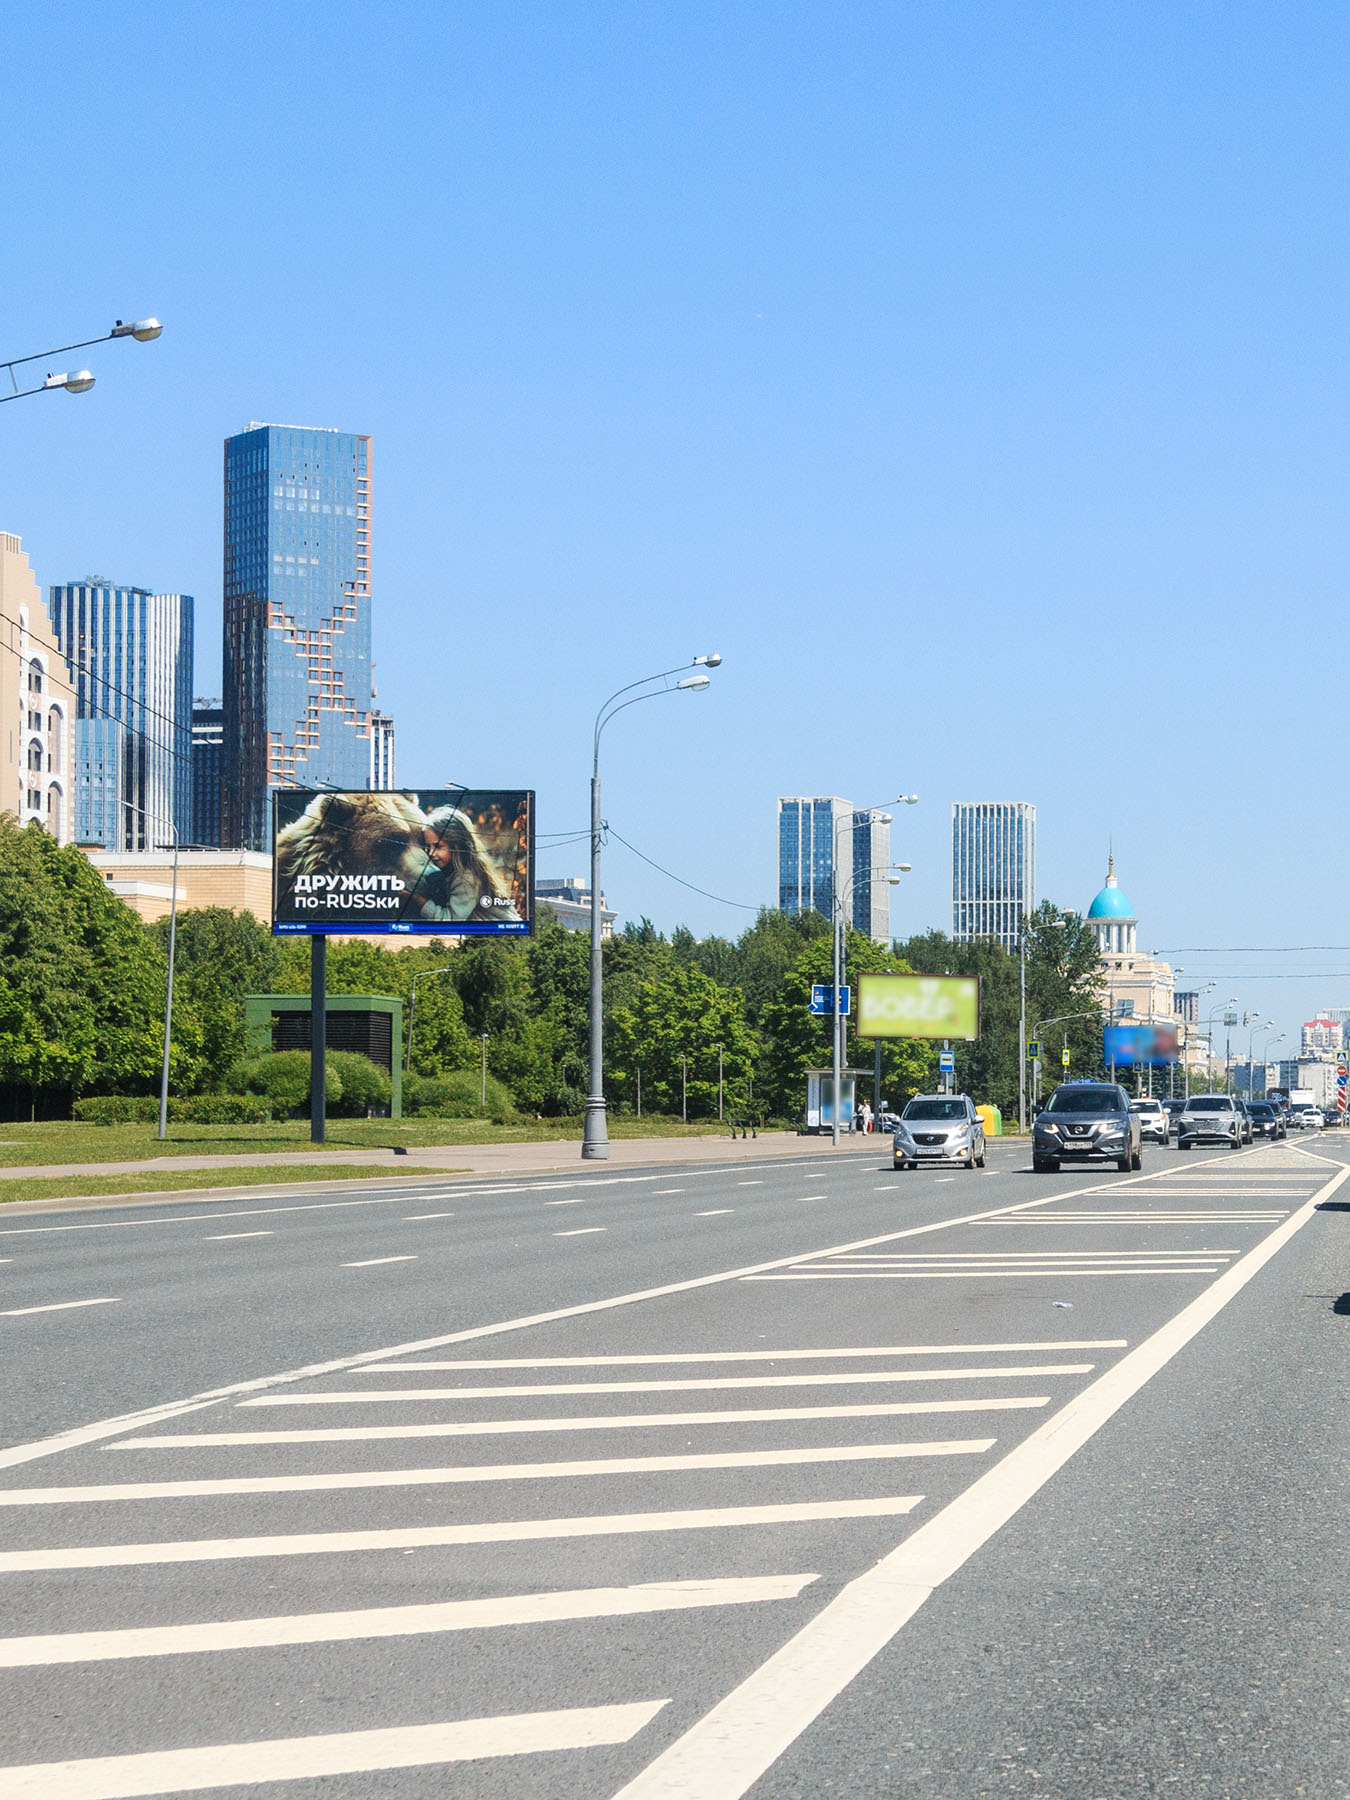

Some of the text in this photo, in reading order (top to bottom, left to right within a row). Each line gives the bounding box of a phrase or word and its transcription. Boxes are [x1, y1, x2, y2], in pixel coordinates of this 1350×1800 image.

[294, 874, 406, 893] ДРУЖИТЬ
[295, 894, 400, 909] по-RUSSки
[493, 897, 516, 906] Russ
